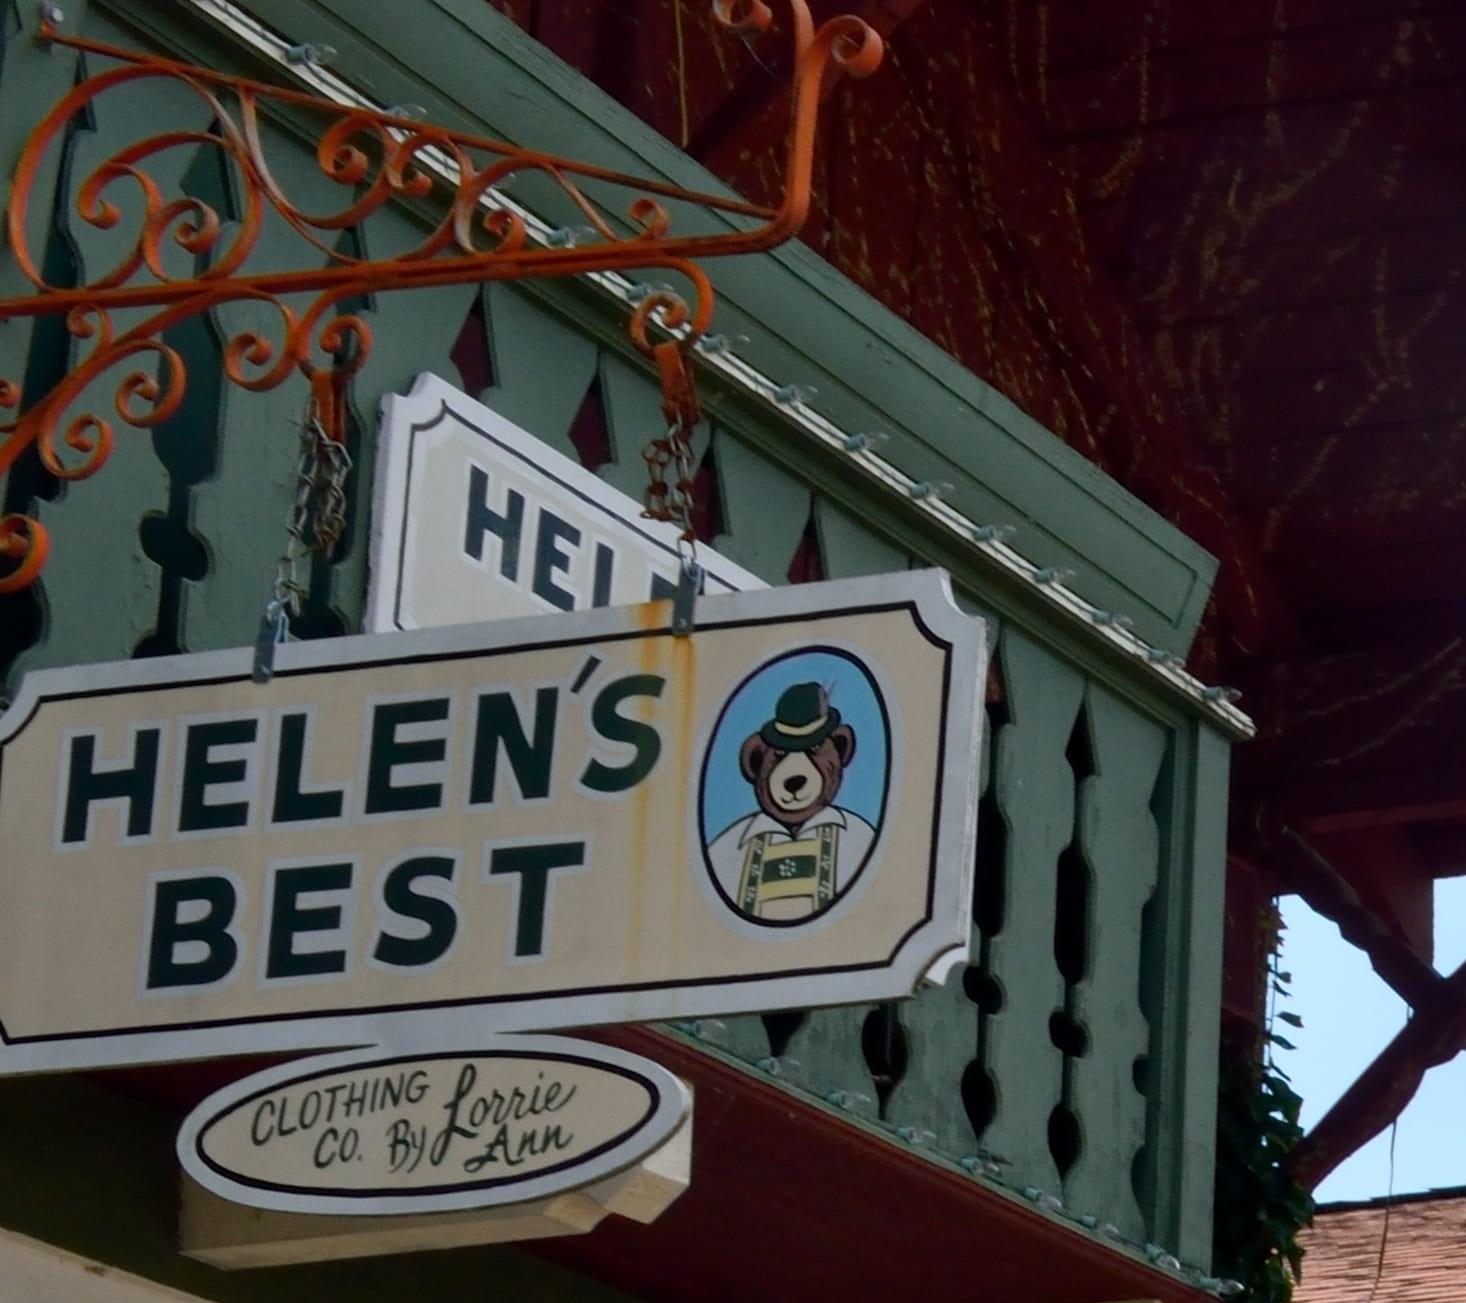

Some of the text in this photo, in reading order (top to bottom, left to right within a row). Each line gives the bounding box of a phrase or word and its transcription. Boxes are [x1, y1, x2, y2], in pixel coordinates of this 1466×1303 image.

[60, 654, 668, 846] HELEN'S
[145, 840, 588, 992] BEST
[250, 1069, 431, 1147] CLOTHING
[313, 1118, 427, 1174] CO. By
[429, 1063, 577, 1167] Lorrie
[463, 1123, 574, 1173] Ann
